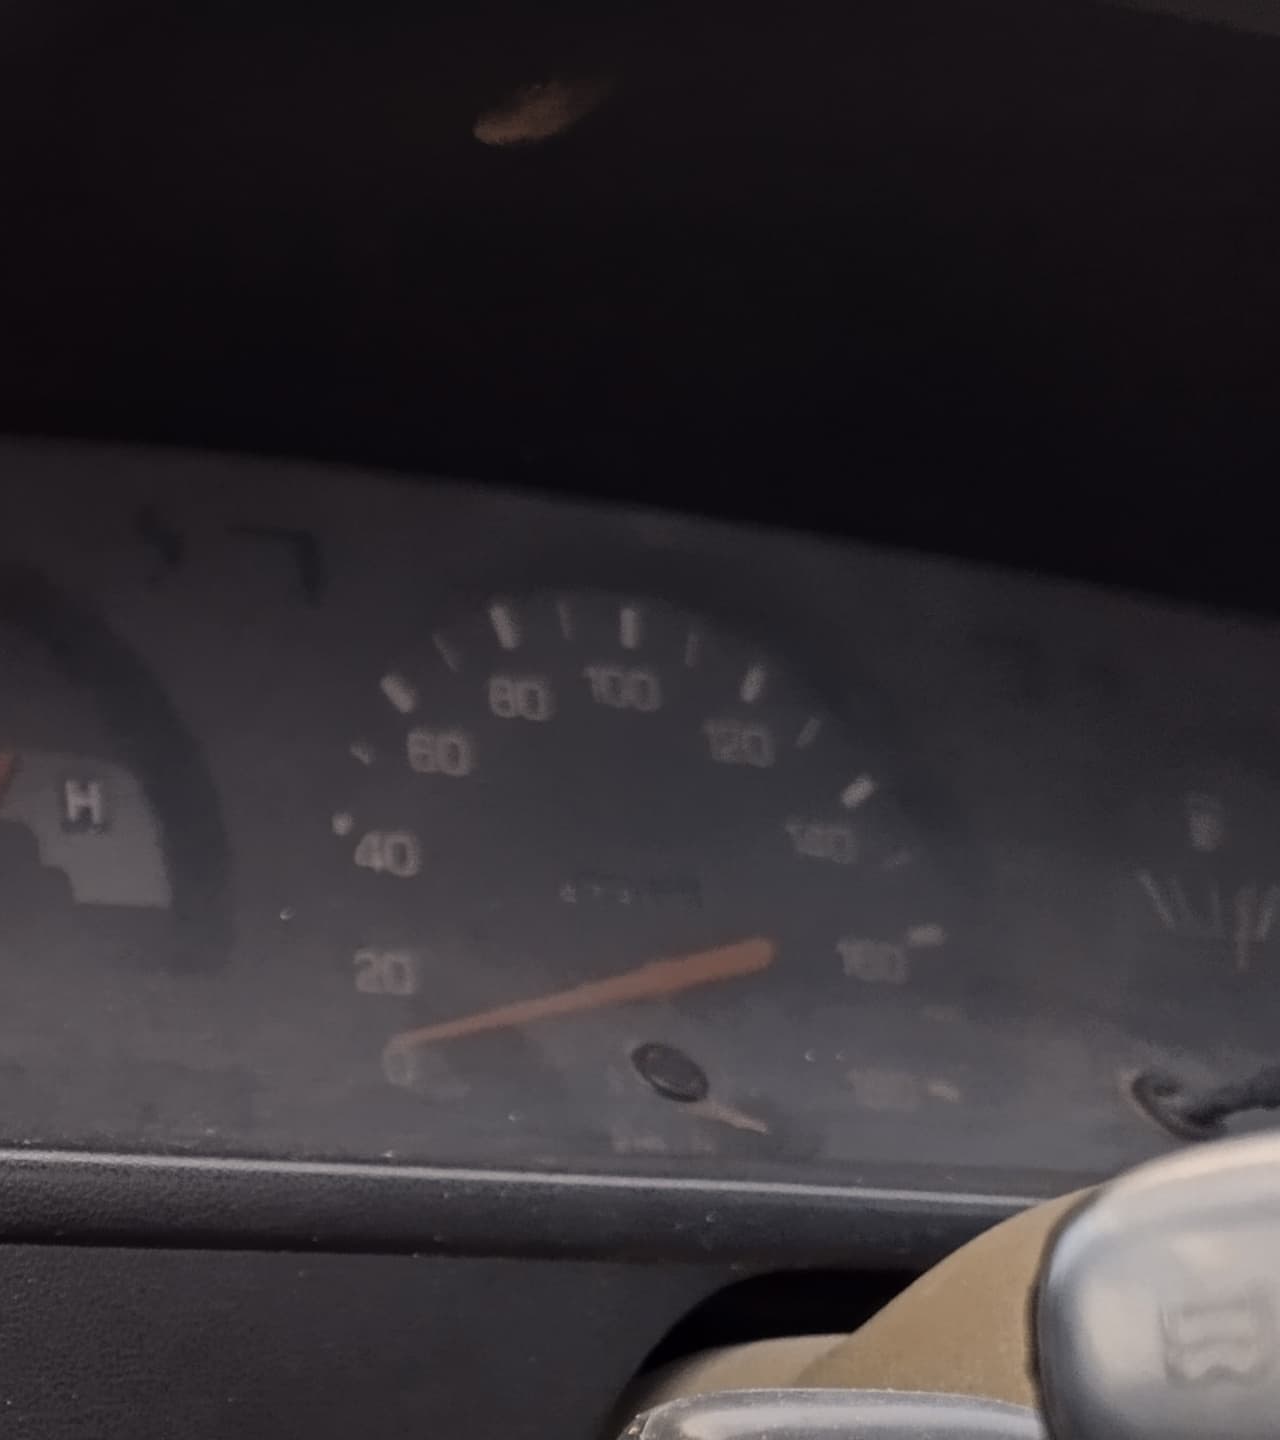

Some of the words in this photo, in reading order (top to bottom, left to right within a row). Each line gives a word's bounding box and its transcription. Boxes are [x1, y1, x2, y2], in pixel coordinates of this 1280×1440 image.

[487, 674, 555, 721] 80
[582, 664, 662, 712] 100
[406, 724, 474, 777] 60
[701, 719, 776, 768] 120
[65, 778, 103, 825] H
[354, 824, 422, 878] 40
[353, 946, 416, 998] 20
